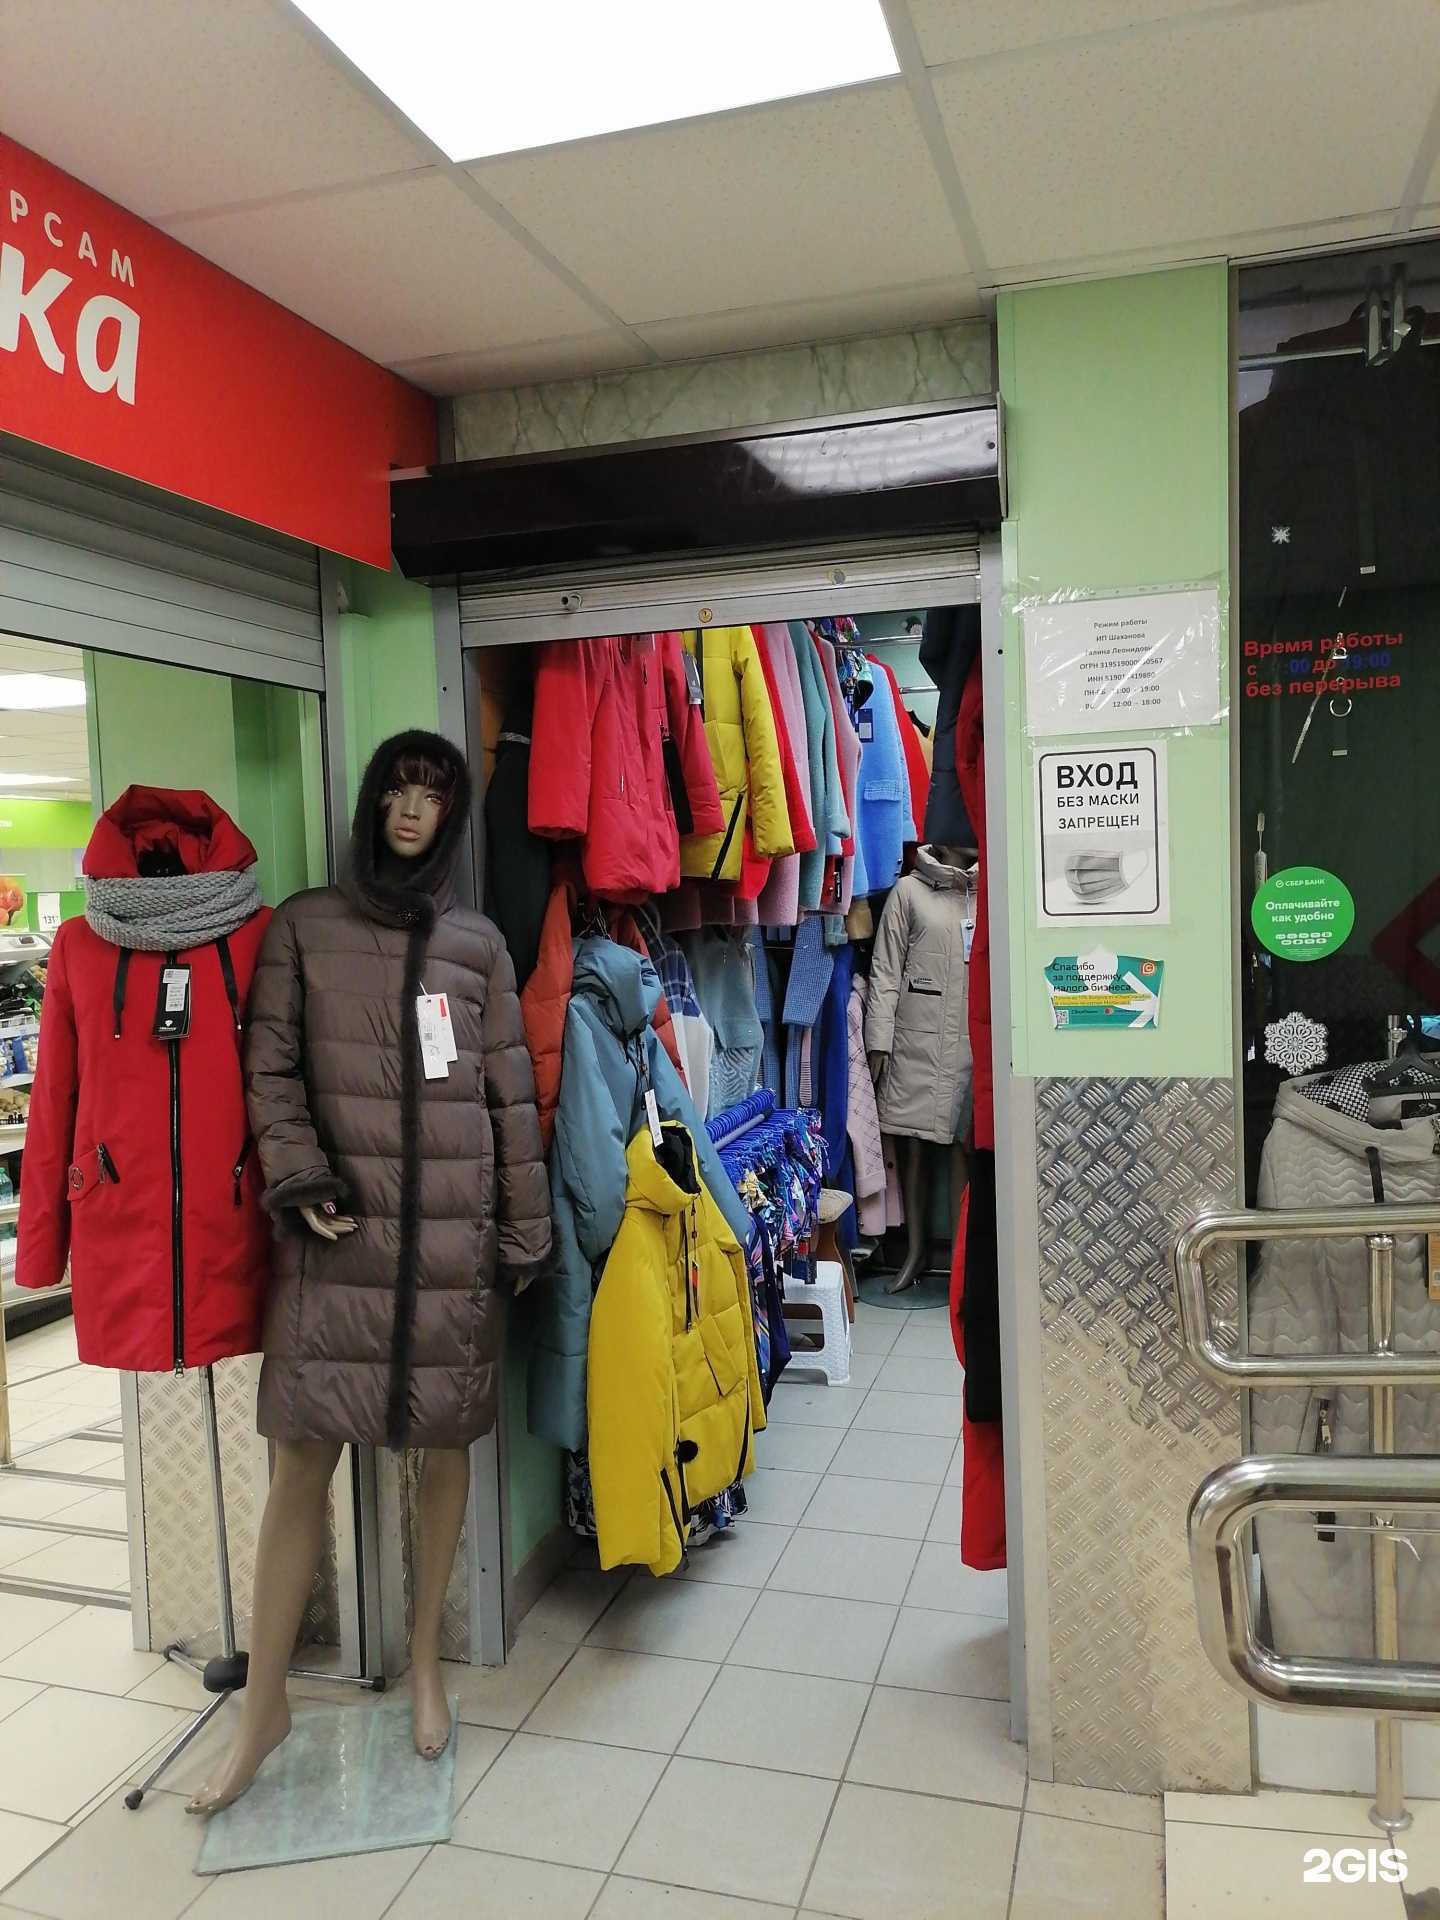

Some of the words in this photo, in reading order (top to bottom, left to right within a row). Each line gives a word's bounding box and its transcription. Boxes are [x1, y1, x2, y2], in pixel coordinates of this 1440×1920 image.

[1120, 619, 1148, 628] работы
[1244, 639, 1313, 658] Время
[1312, 659, 1337, 674] до
[1245, 683, 1282, 698] без
[1288, 674, 1401, 695] перерыва
[1113, 700, 1132, 708] 12:00
[1057, 762, 1139, 790] ВХОД
[1057, 795, 1084, 808] БЕЗ
[1089, 793, 1139, 807] МАСКИ
[1058, 814, 1139, 829] ЗАПРЕЩЕН
[1265, 897, 1340, 911] Оплачивайте
[1272, 915, 1291, 923] как
[1294, 911, 1335, 923] удобно
[1052, 961, 1095, 971] Спасибо
[1066, 974, 1122, 982] поддержку
[1091, 983, 1131, 992] бизнеса
